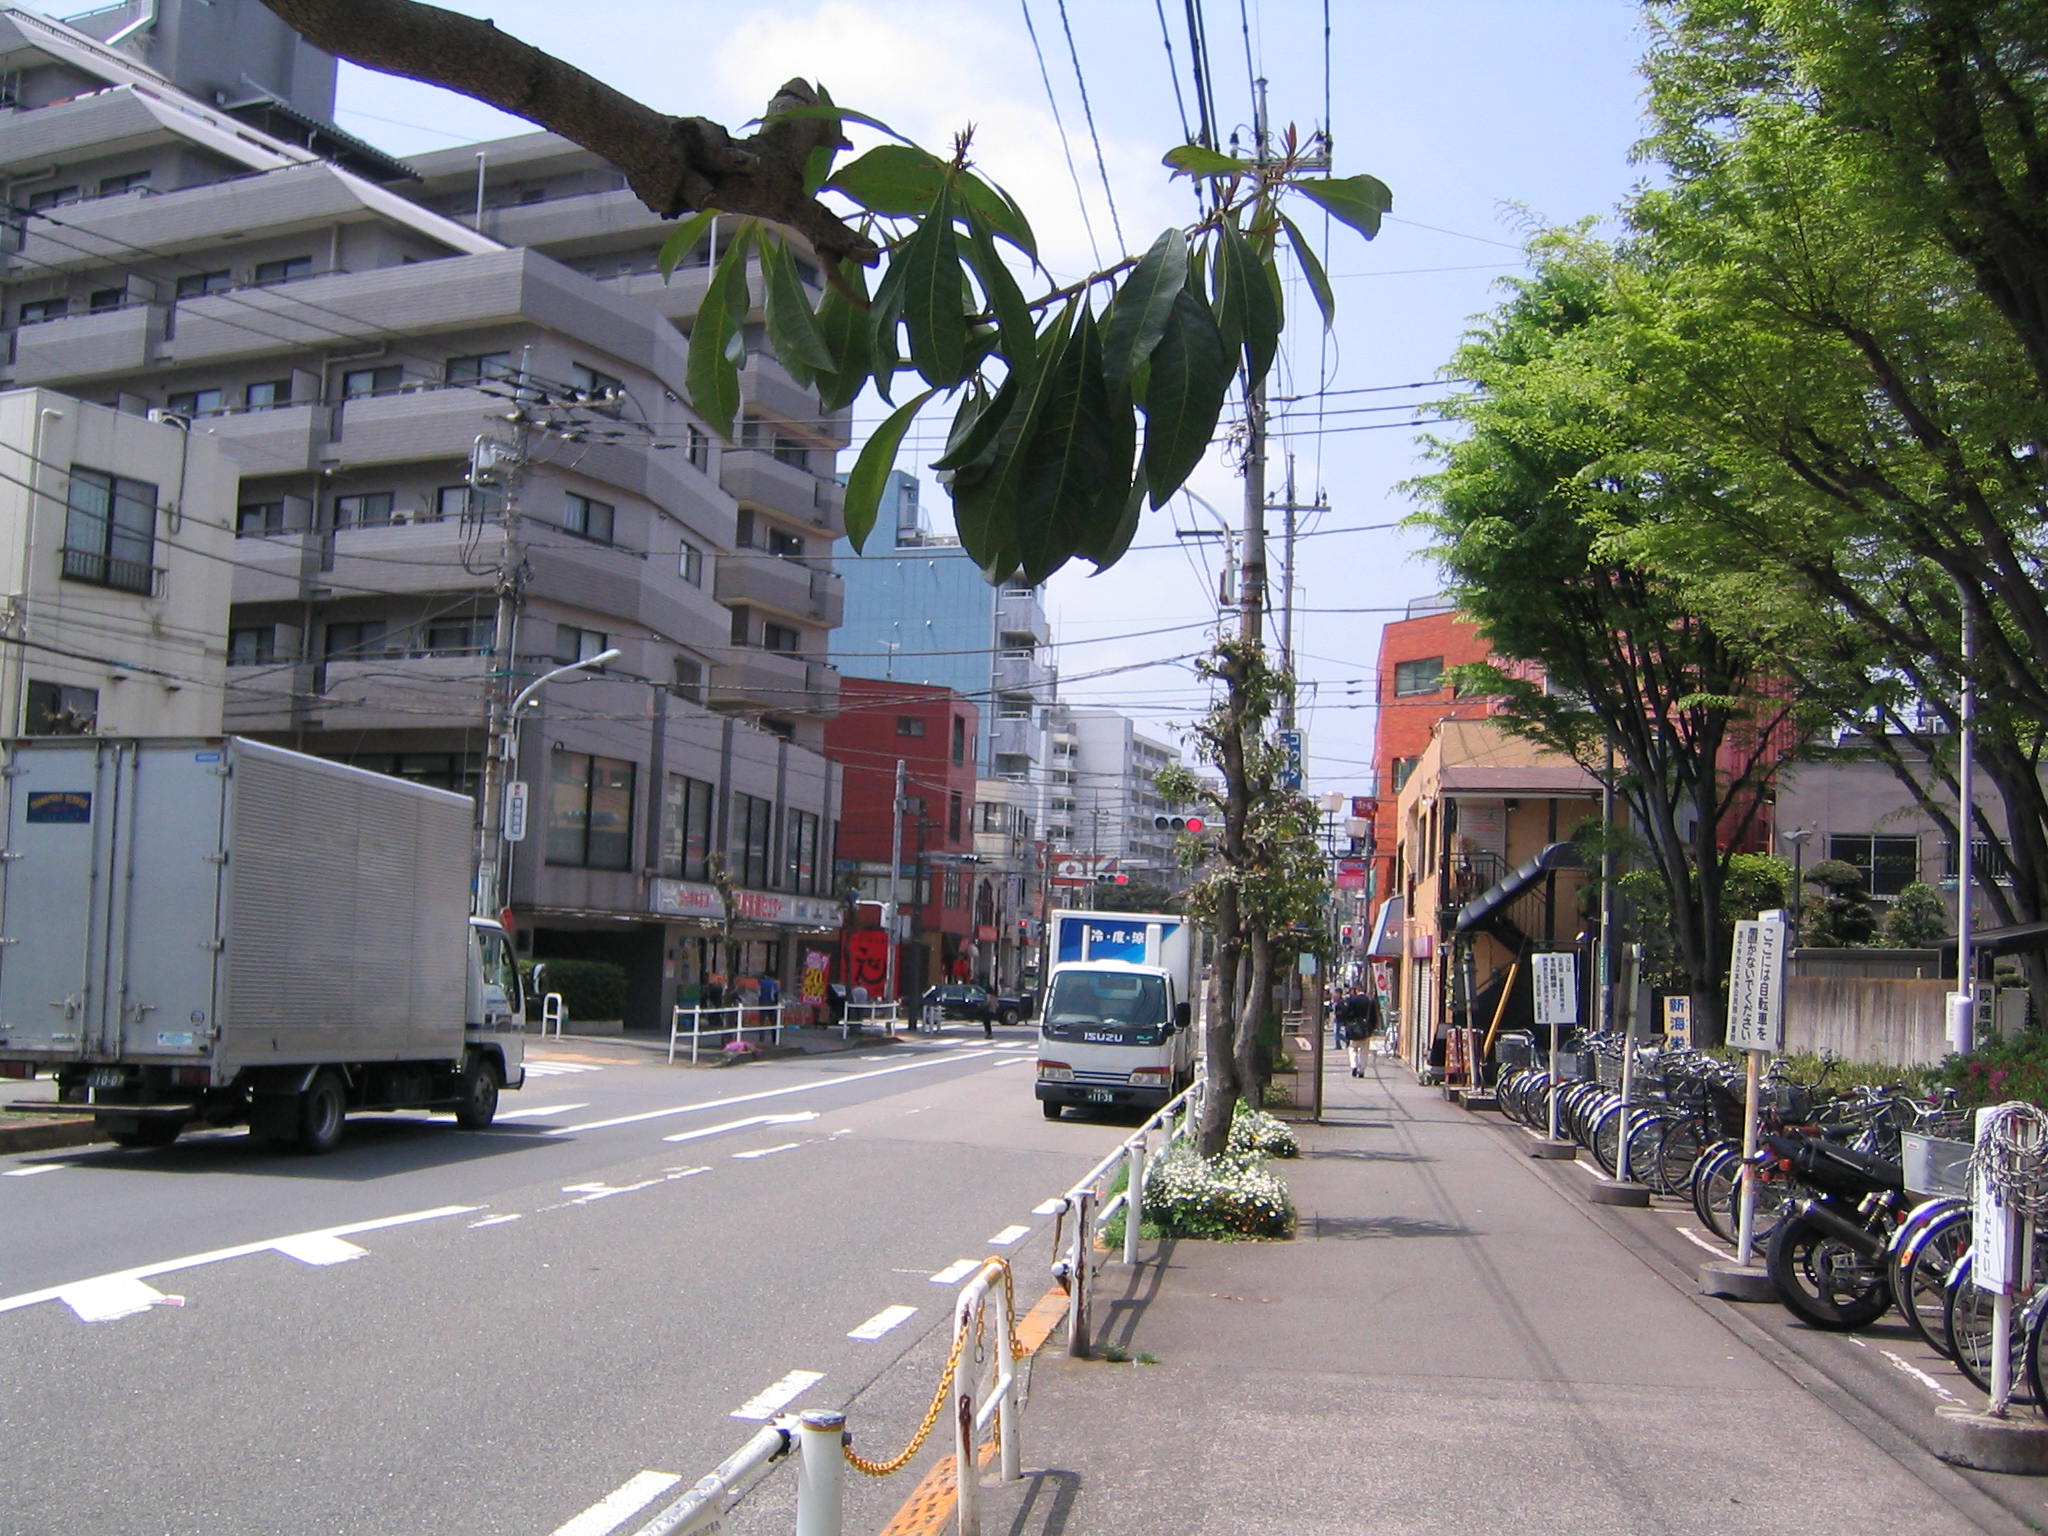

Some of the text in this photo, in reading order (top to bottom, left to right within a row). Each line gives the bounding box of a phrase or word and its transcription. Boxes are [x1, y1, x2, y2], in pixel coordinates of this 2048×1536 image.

[1757, 927, 1774, 1041] ここには自転車を
[1083, 1031, 1124, 1043] ISUZU
